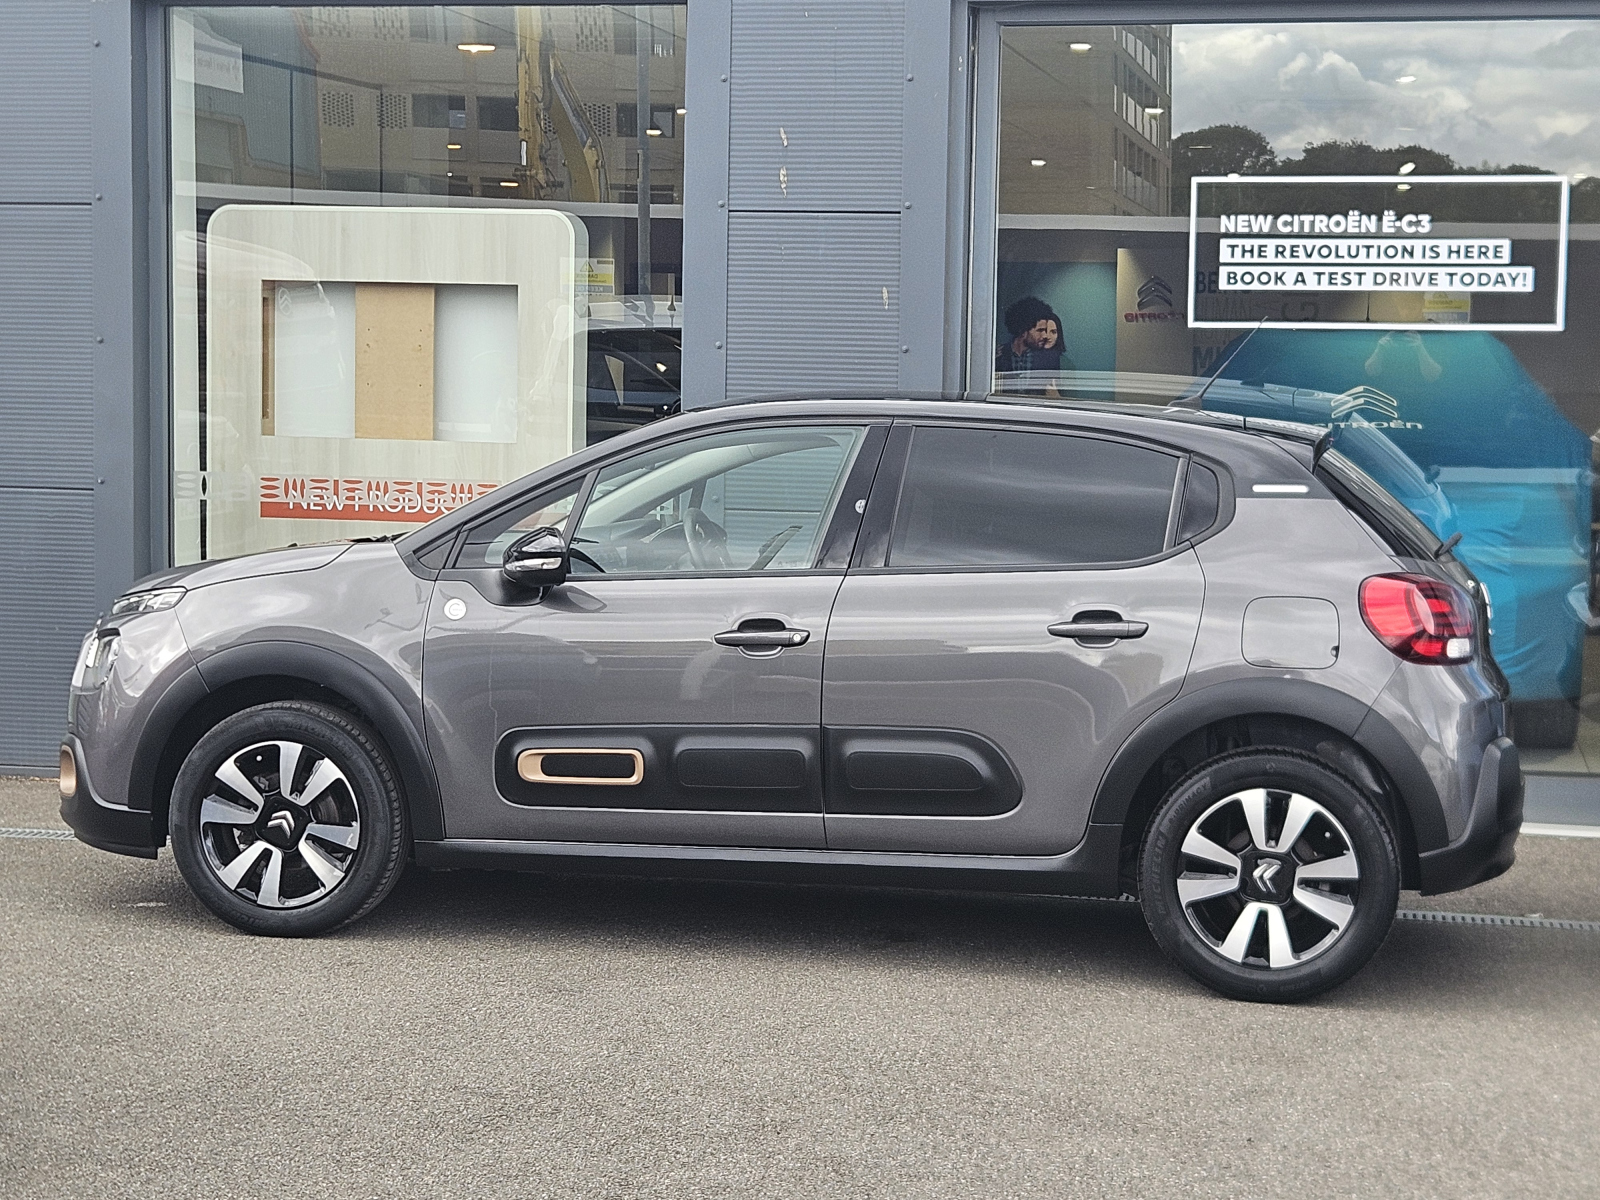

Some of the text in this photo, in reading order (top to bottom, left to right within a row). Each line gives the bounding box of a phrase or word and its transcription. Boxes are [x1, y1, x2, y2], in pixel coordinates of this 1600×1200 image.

[1220, 214, 1273, 233] NEW
[1276, 210, 1377, 233] CITROËN
[1226, 244, 1504, 260] THE REVOLUTION IS HERE
[1226, 271, 1287, 286] BOOK
[1292, 271, 1307, 286] A
[1313, 271, 1367, 286] TEST
[1372, 271, 1439, 287] DRIVE
[1445, 272, 1527, 287] TODAY!
